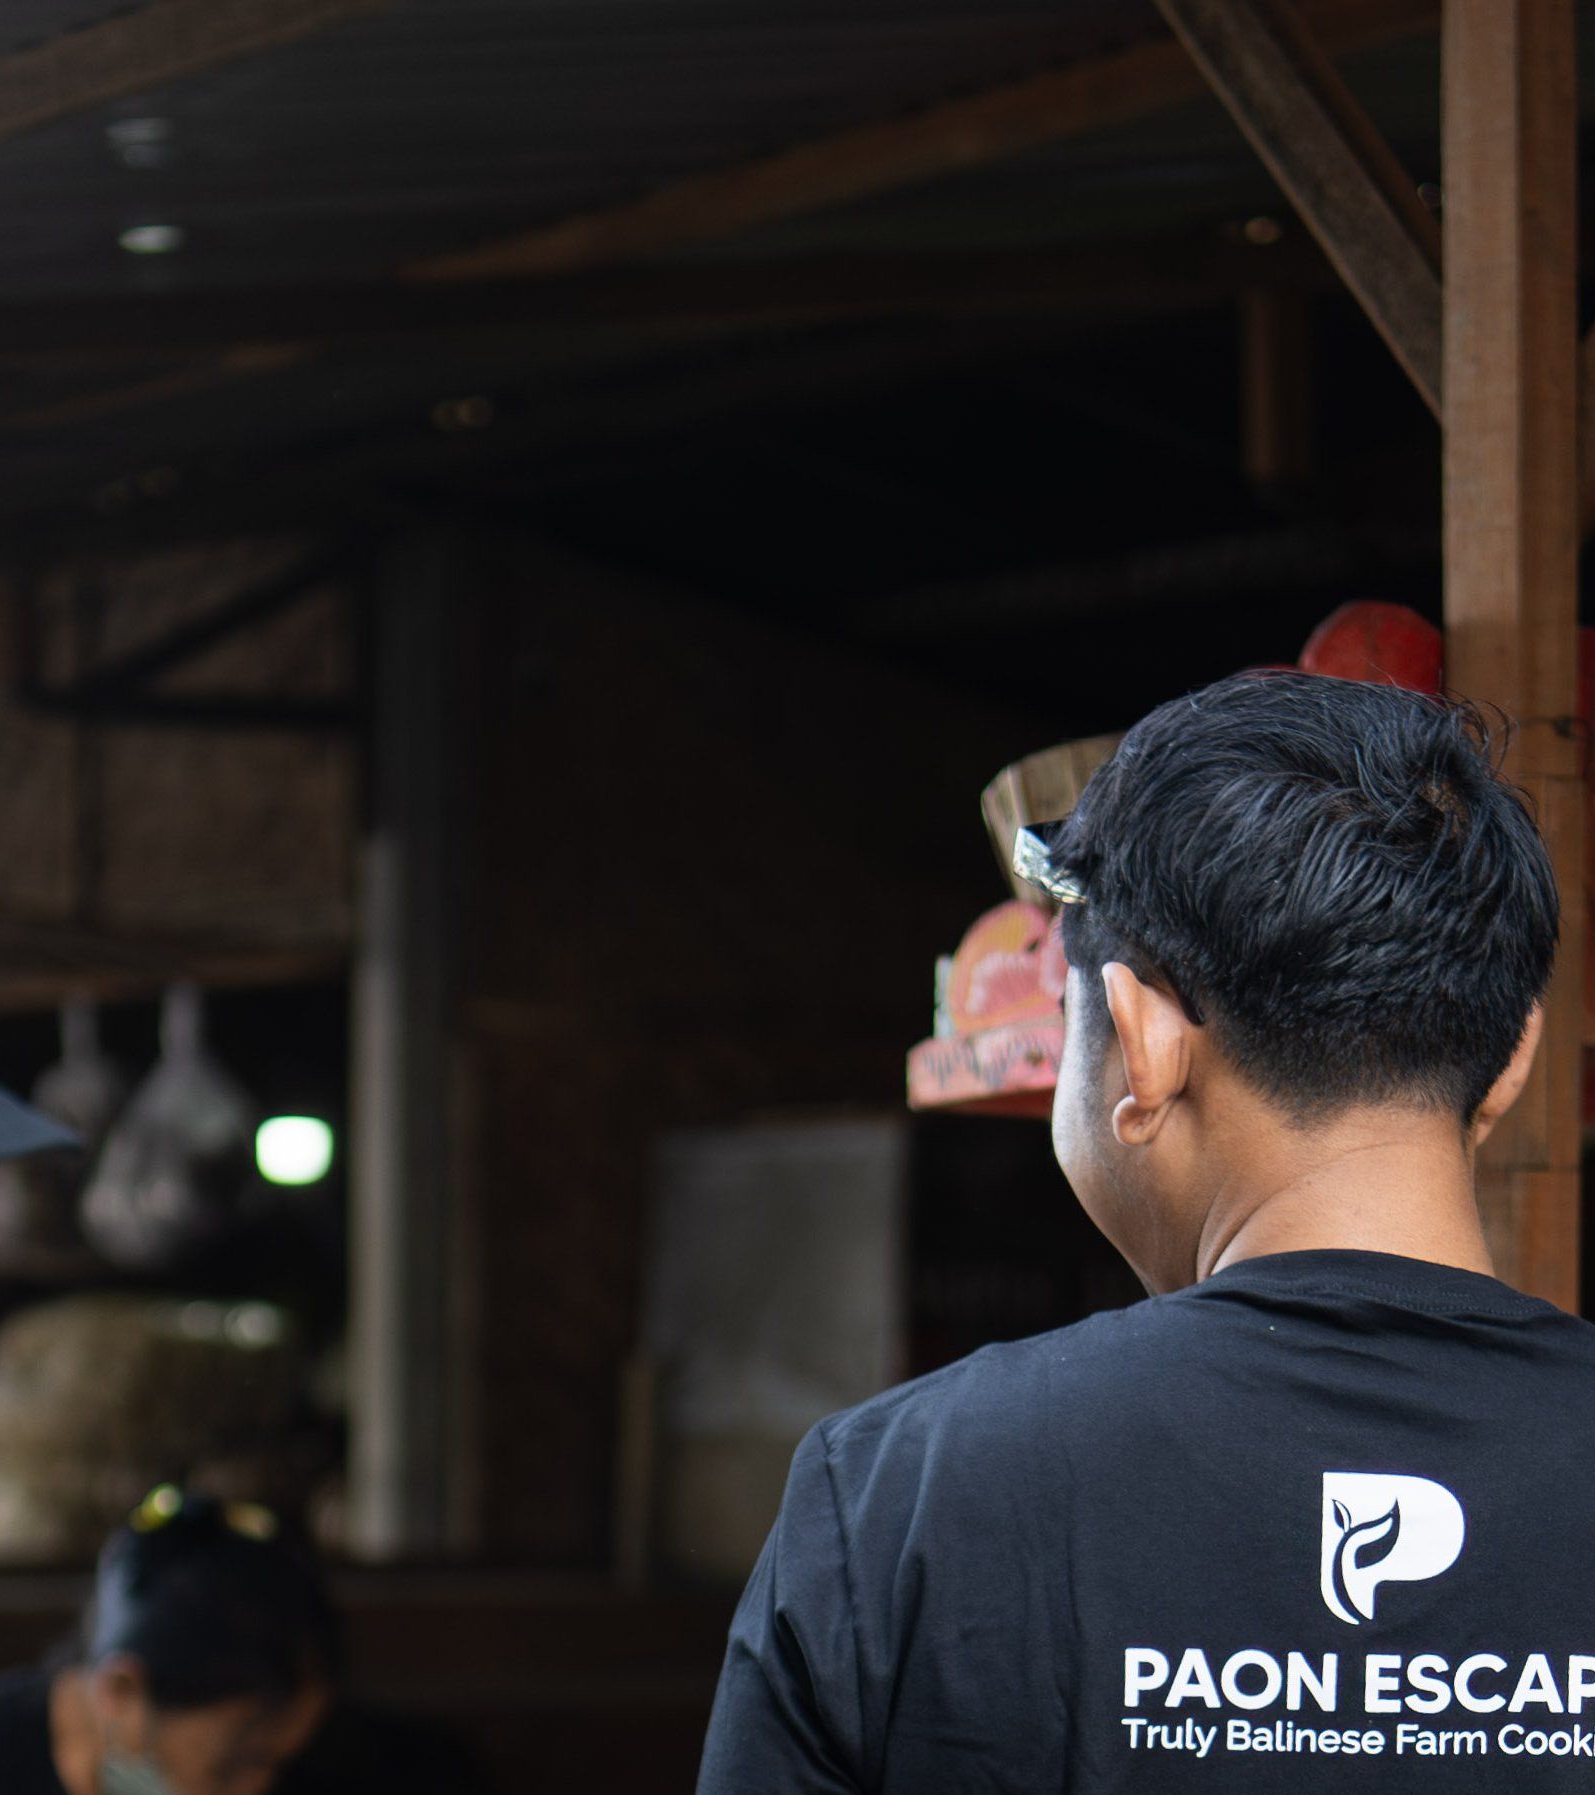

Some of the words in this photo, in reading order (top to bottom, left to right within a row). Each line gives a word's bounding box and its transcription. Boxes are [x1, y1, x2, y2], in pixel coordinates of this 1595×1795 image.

[1123, 1647, 1338, 1713] PAON
[1121, 1717, 1214, 1759] Truly
[1226, 1720, 1385, 1756] Balinese
[1395, 1724, 1488, 1758] Farm
